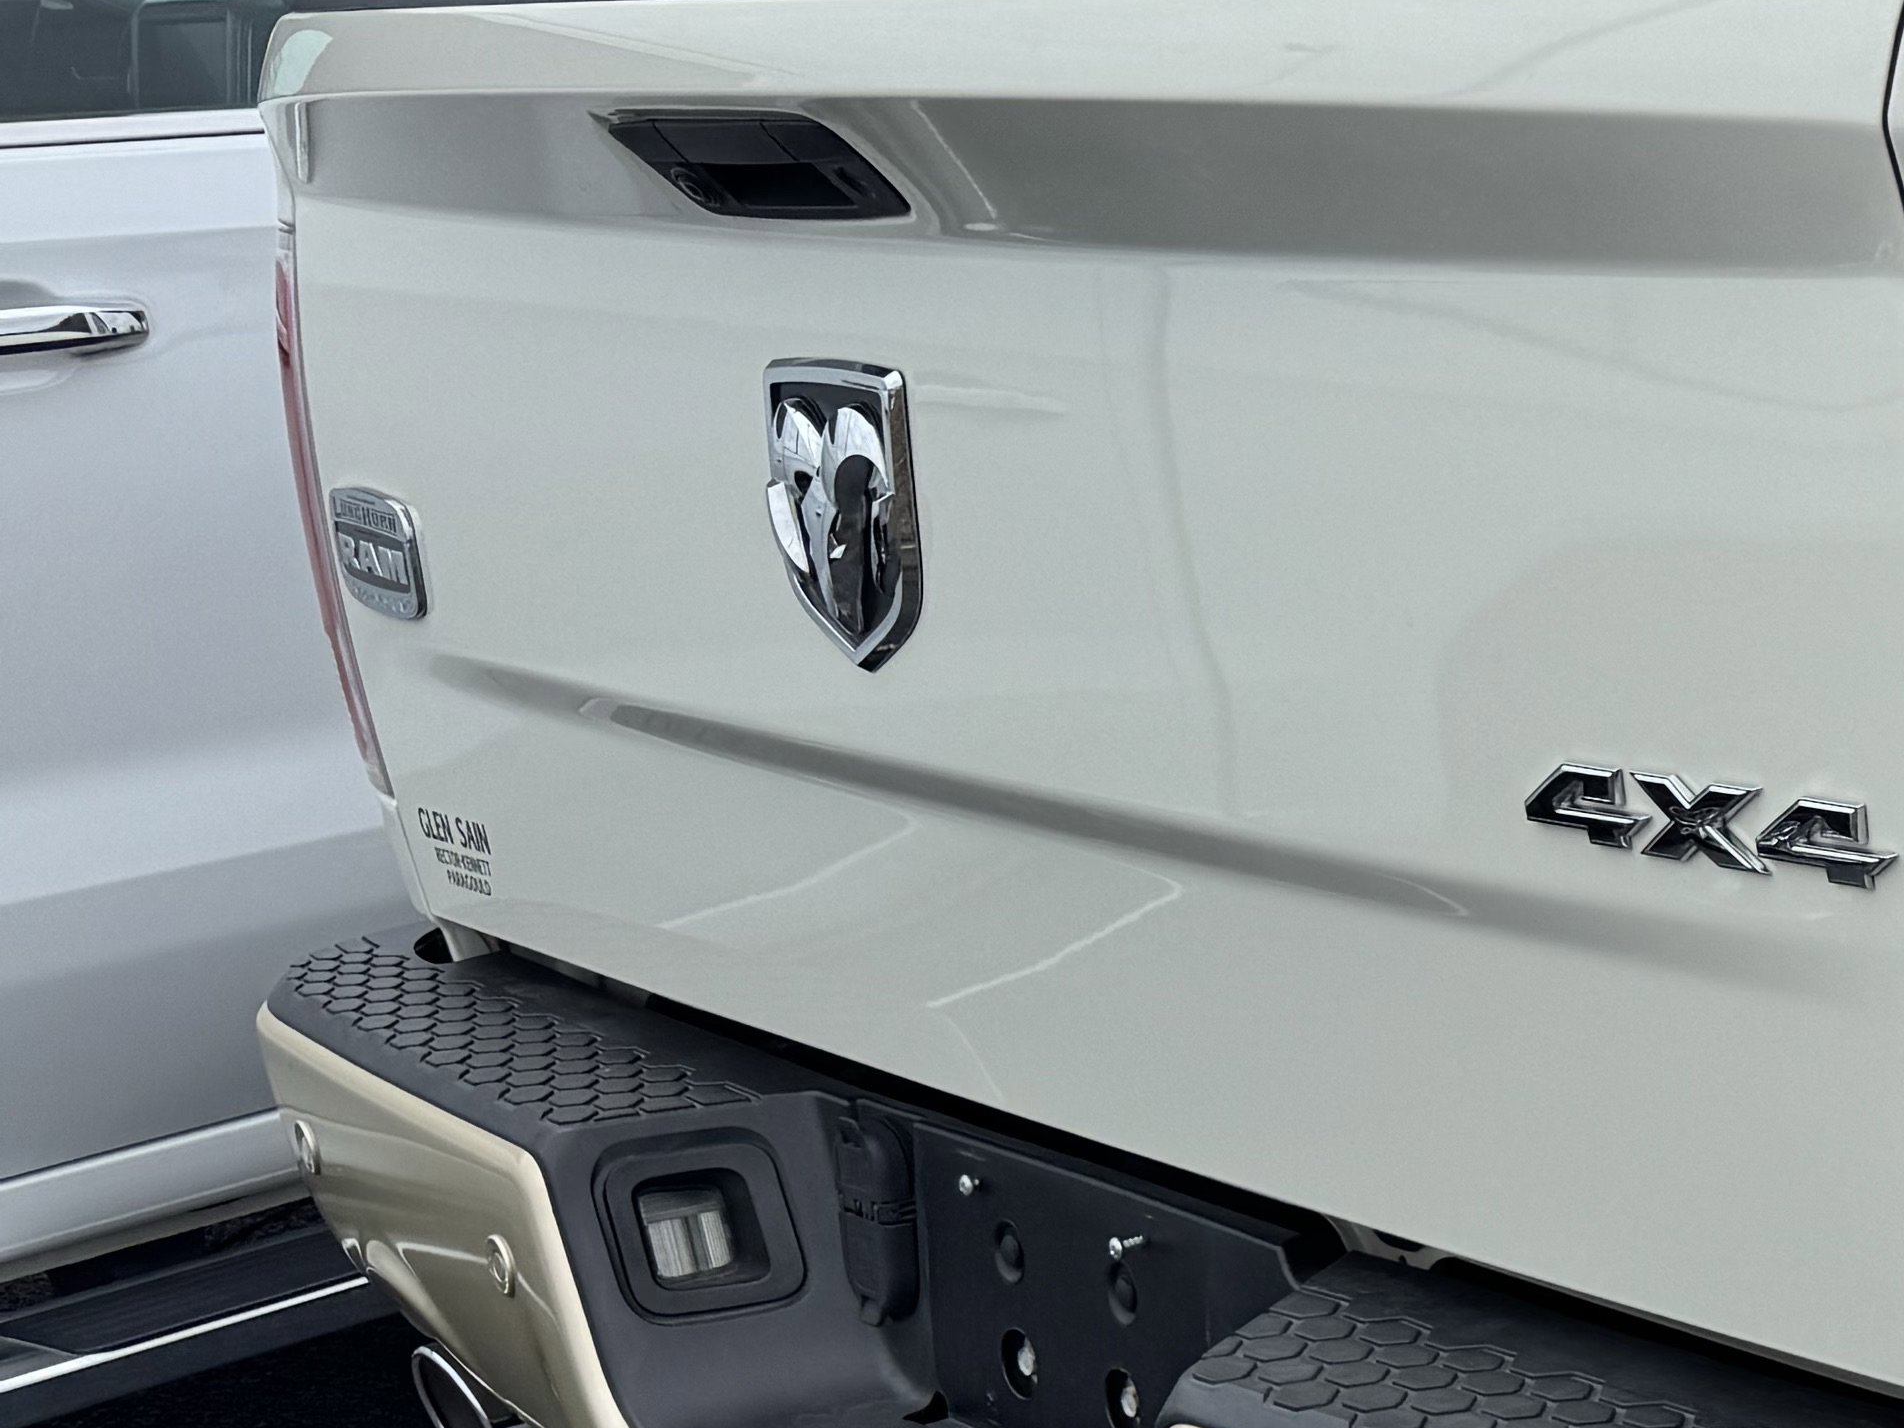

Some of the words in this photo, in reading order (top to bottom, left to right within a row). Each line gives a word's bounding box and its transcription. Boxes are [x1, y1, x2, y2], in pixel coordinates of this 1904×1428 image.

[338, 532, 411, 586] RAM
[417, 807, 454, 844] GLEN
[455, 816, 492, 855] SAIN
